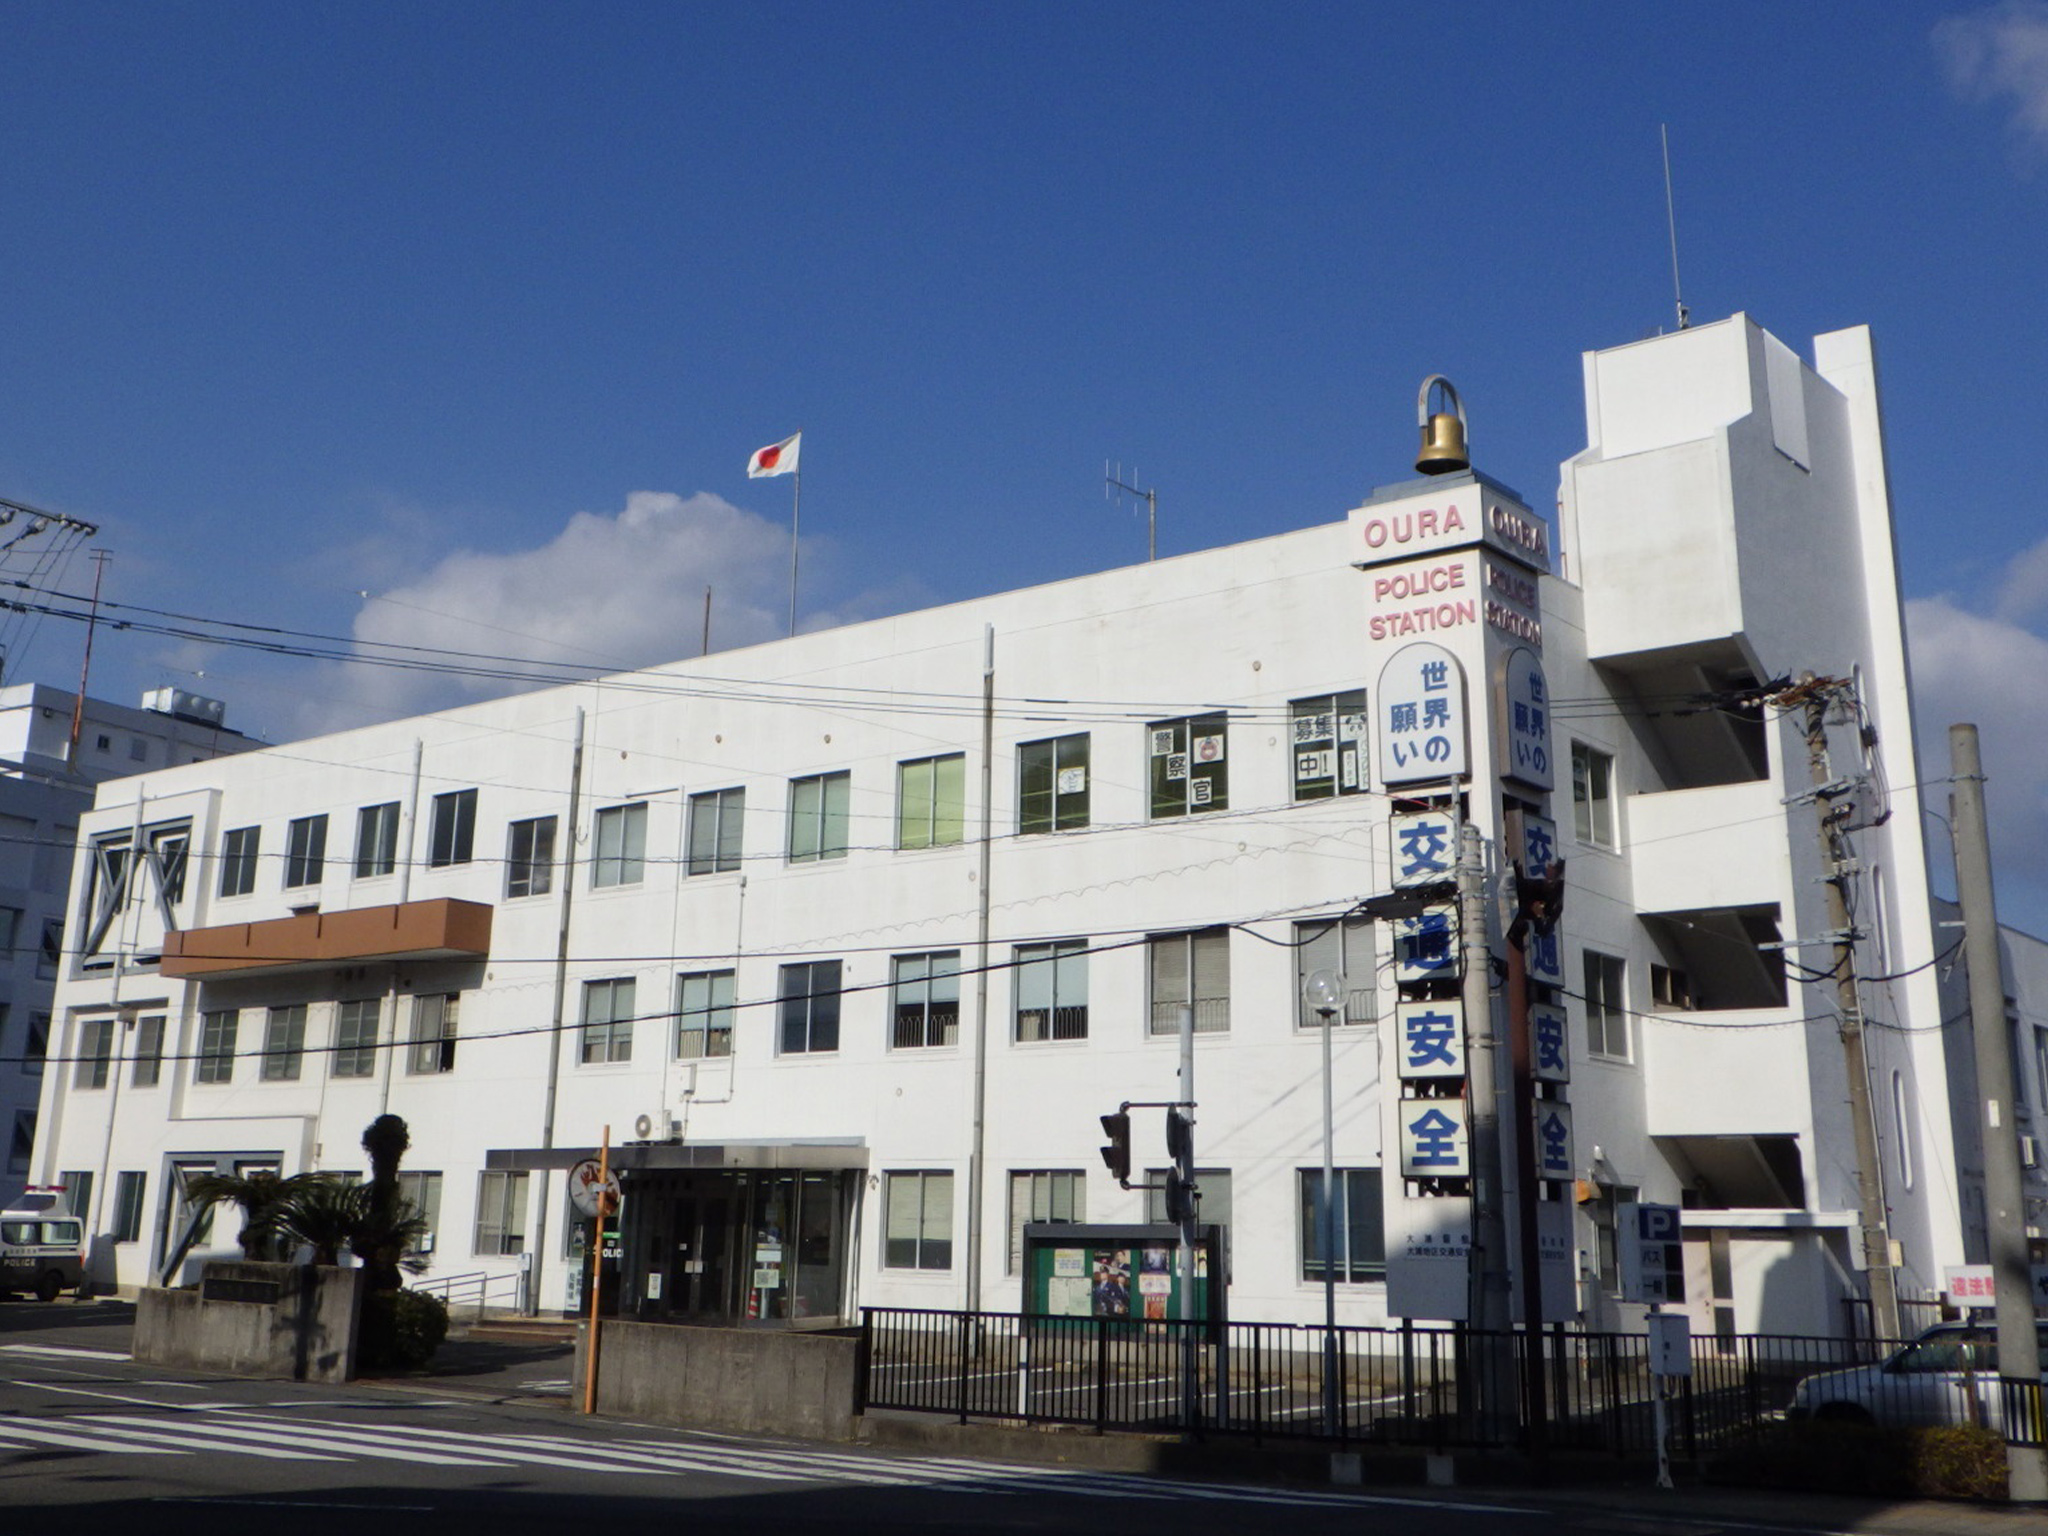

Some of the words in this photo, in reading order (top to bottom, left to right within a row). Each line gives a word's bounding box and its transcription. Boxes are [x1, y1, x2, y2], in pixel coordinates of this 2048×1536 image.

[1364, 504, 1465, 548] OURA
[1490, 505, 1545, 556] OURA
[1374, 563, 1465, 603] POLICE
[1486, 563, 1537, 610] POLICE
[1369, 599, 1476, 641] STATION
[1485, 600, 1543, 647] STATION
[1295, 715, 1334, 741] 募集
[1390, 702, 1419, 768] 願い
[1420, 661, 1451, 763] 世界の
[1514, 701, 1531, 767] 願い
[1529, 672, 1547, 775] 世界の
[1398, 821, 1460, 1167] 交通安全
[1647, 1210, 1671, 1238] P
[3, 1258, 36, 1267] POLICE
